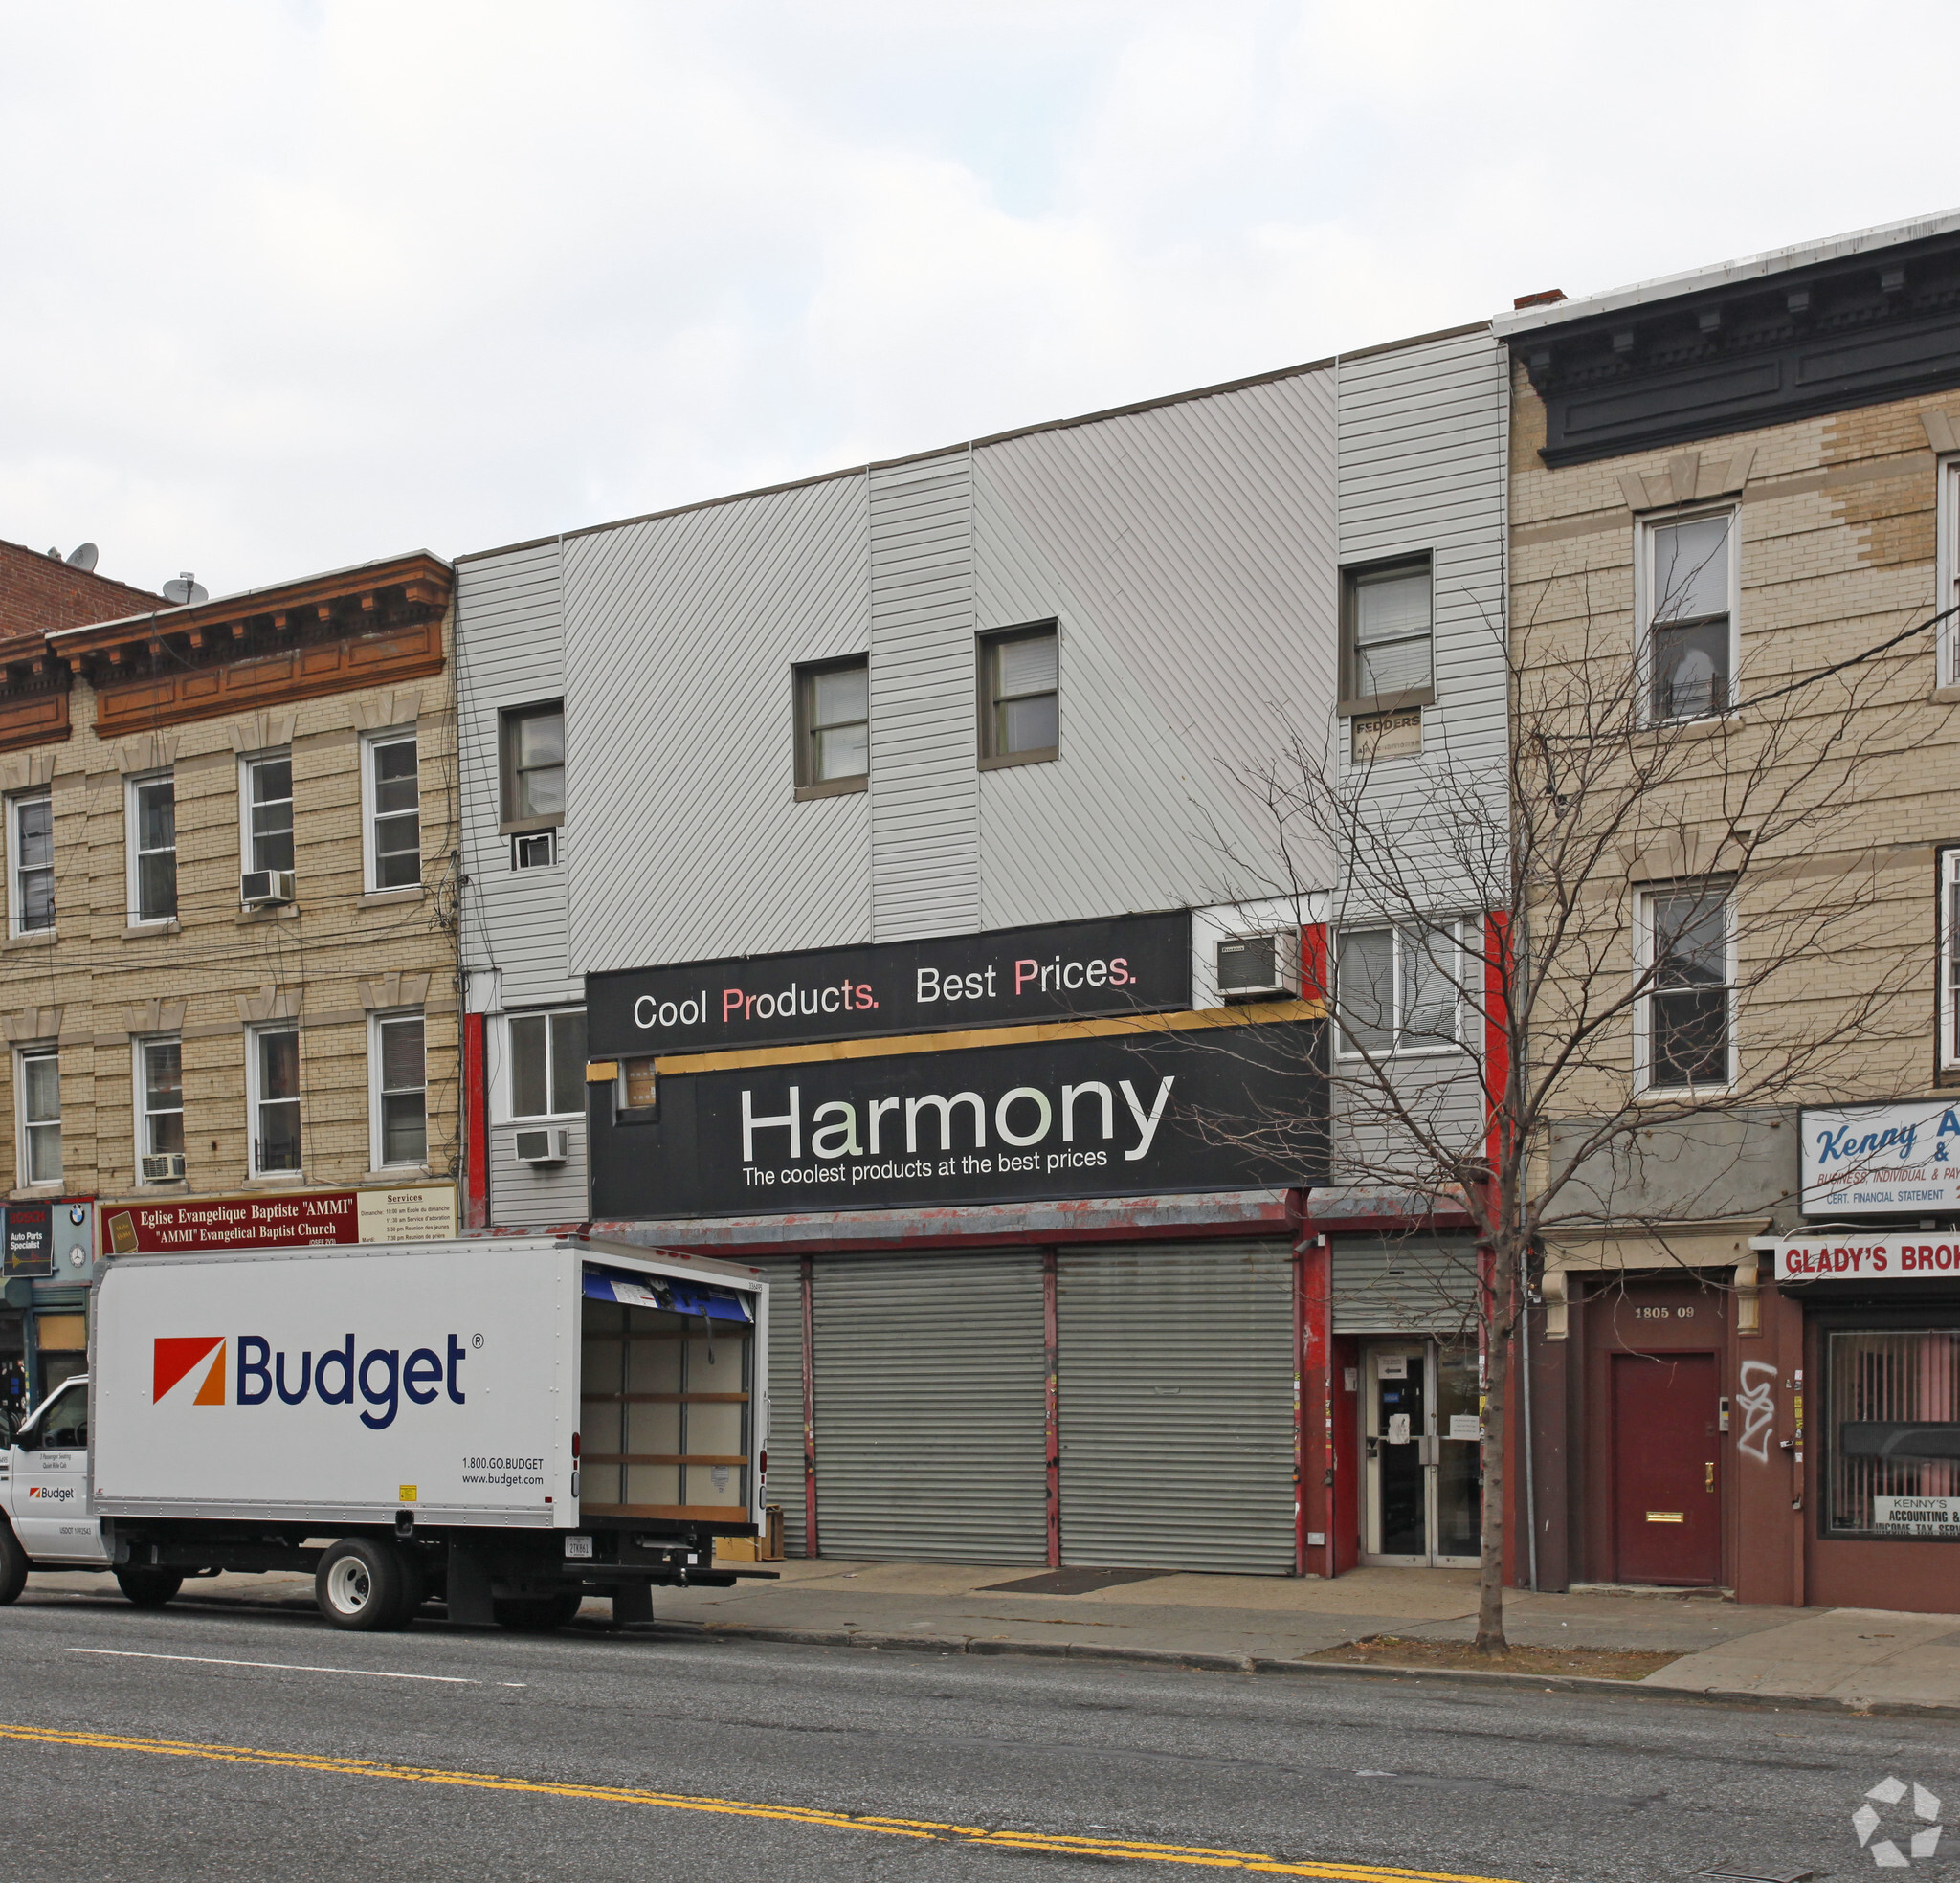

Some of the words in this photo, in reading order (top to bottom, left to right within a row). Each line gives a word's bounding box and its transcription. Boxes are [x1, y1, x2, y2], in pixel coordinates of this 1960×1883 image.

[1357, 716, 1420, 734] FEDDERS
[634, 989, 706, 1029] Cool
[723, 979, 880, 1023] Products.
[917, 964, 997, 1003] Best
[1014, 955, 1137, 996] Prices.
[741, 1075, 1175, 1162] Harmony
[1816, 1122, 1917, 1164] Kenny
[1934, 1141, 1949, 1162] &
[743, 1166, 775, 1185] The
[781, 1163, 846, 1184] coolest
[852, 1160, 932, 1185] products
[938, 1158, 956, 1176] at
[962, 1155, 992, 1174] the
[998, 1151, 1040, 1173] best
[1047, 1148, 1108, 1174] prices
[1873, 1168, 1926, 1184] INDIVIDUAL
[1931, 1168, 1939, 1181] &
[387, 1194, 423, 1203] Services
[1827, 1192, 1849, 1205] CERT.
[1853, 1191, 1894, 1204] FINANCIAL
[1898, 1189, 1944, 1202] STATEMENT
[10, 1211, 46, 1224] BOSCH
[140, 1210, 174, 1229] Eglise
[178, 1206, 246, 1226] Evangelique
[251, 1203, 299, 1222] Baptiste
[302, 1198, 353, 1216] "AMMI"
[156, 1229, 198, 1243] "AMMI"
[200, 1226, 256, 1243] Evangelical
[259, 1225, 296, 1240] Baptist
[298, 1222, 336, 1236] Church
[11, 1241, 40, 1251] Specialist
[1786, 1246, 1888, 1274] GLADY'S
[1635, 1307, 1669, 1318] 1805
[1677, 1307, 1694, 1318] 09
[237, 1333, 466, 1430] Budget
[462, 1457, 544, 1470] 1.800.GO.BUDGET
[462, 1473, 544, 1487] www.budget.com
[41, 1487, 74, 1502] Budget
[1894, 1499, 1947, 1509] KENNY'S
[1889, 1510, 1949, 1522] ACCOUNTING
[1952, 1511, 1960, 1523] &
